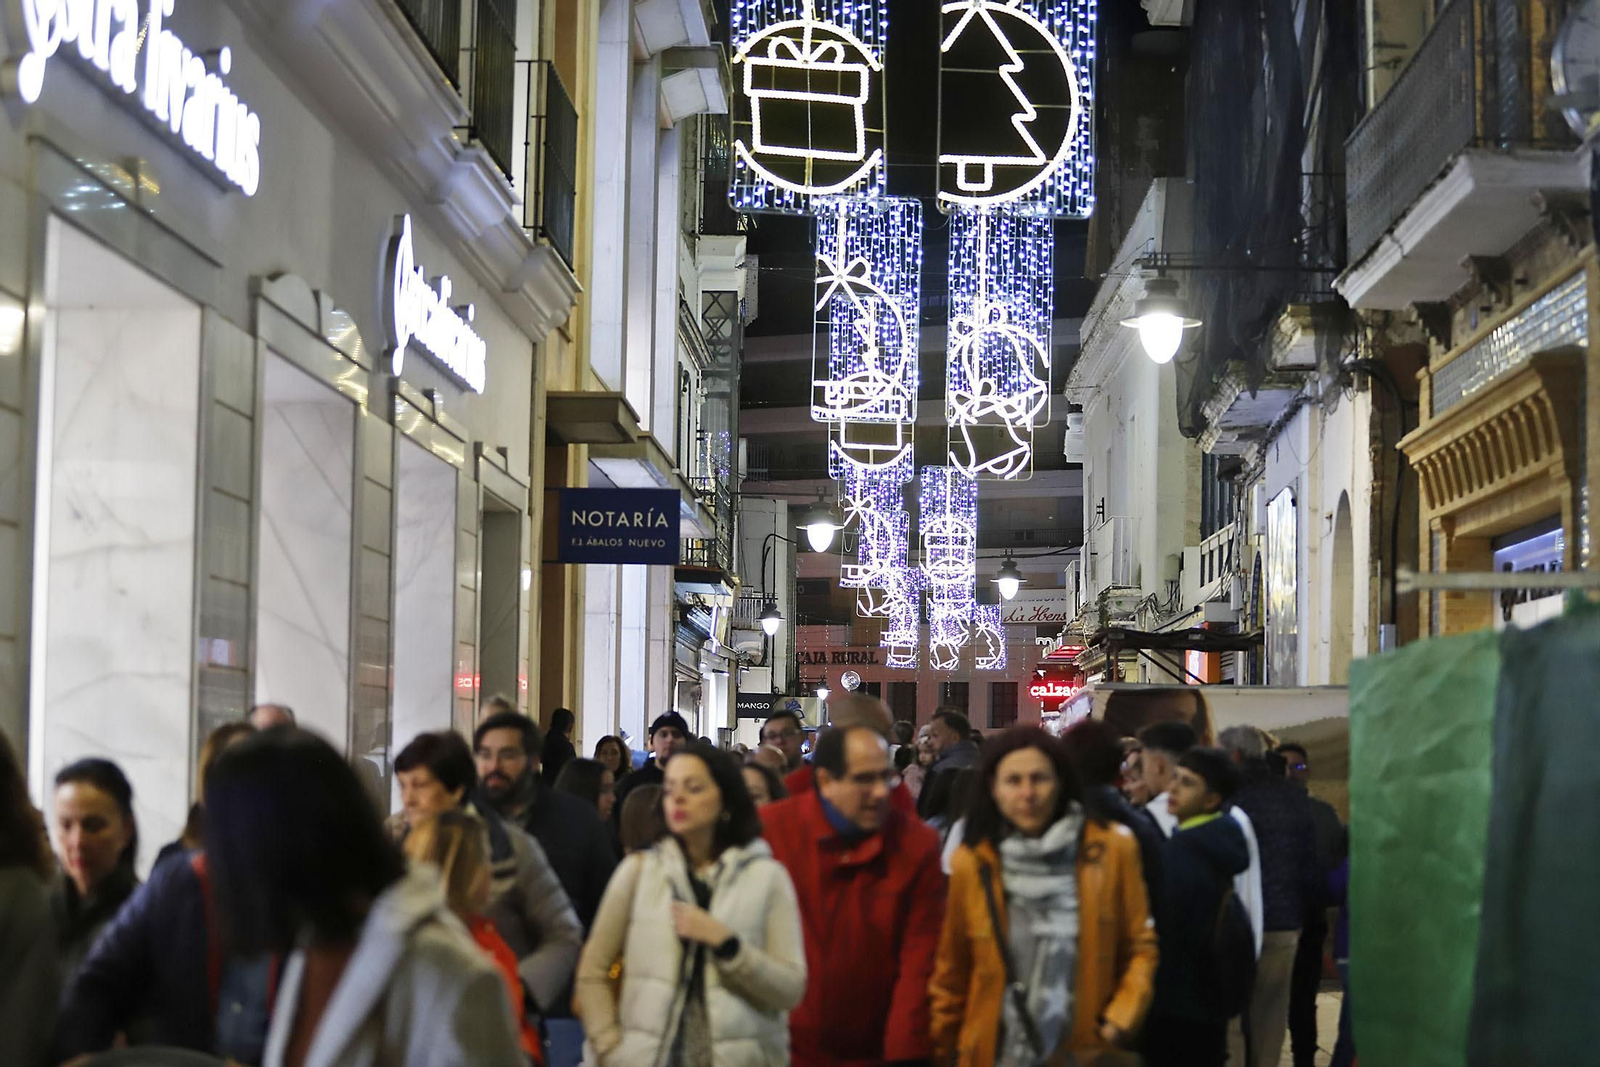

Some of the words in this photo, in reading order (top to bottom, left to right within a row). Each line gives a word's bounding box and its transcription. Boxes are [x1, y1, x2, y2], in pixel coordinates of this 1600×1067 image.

[572, 507, 669, 528] NOTARÍA
[586, 536, 623, 547] ÁBALOS
[628, 539, 666, 548] NUEVO
[831, 651, 879, 664] RURAL
[737, 702, 770, 710] MANGO
